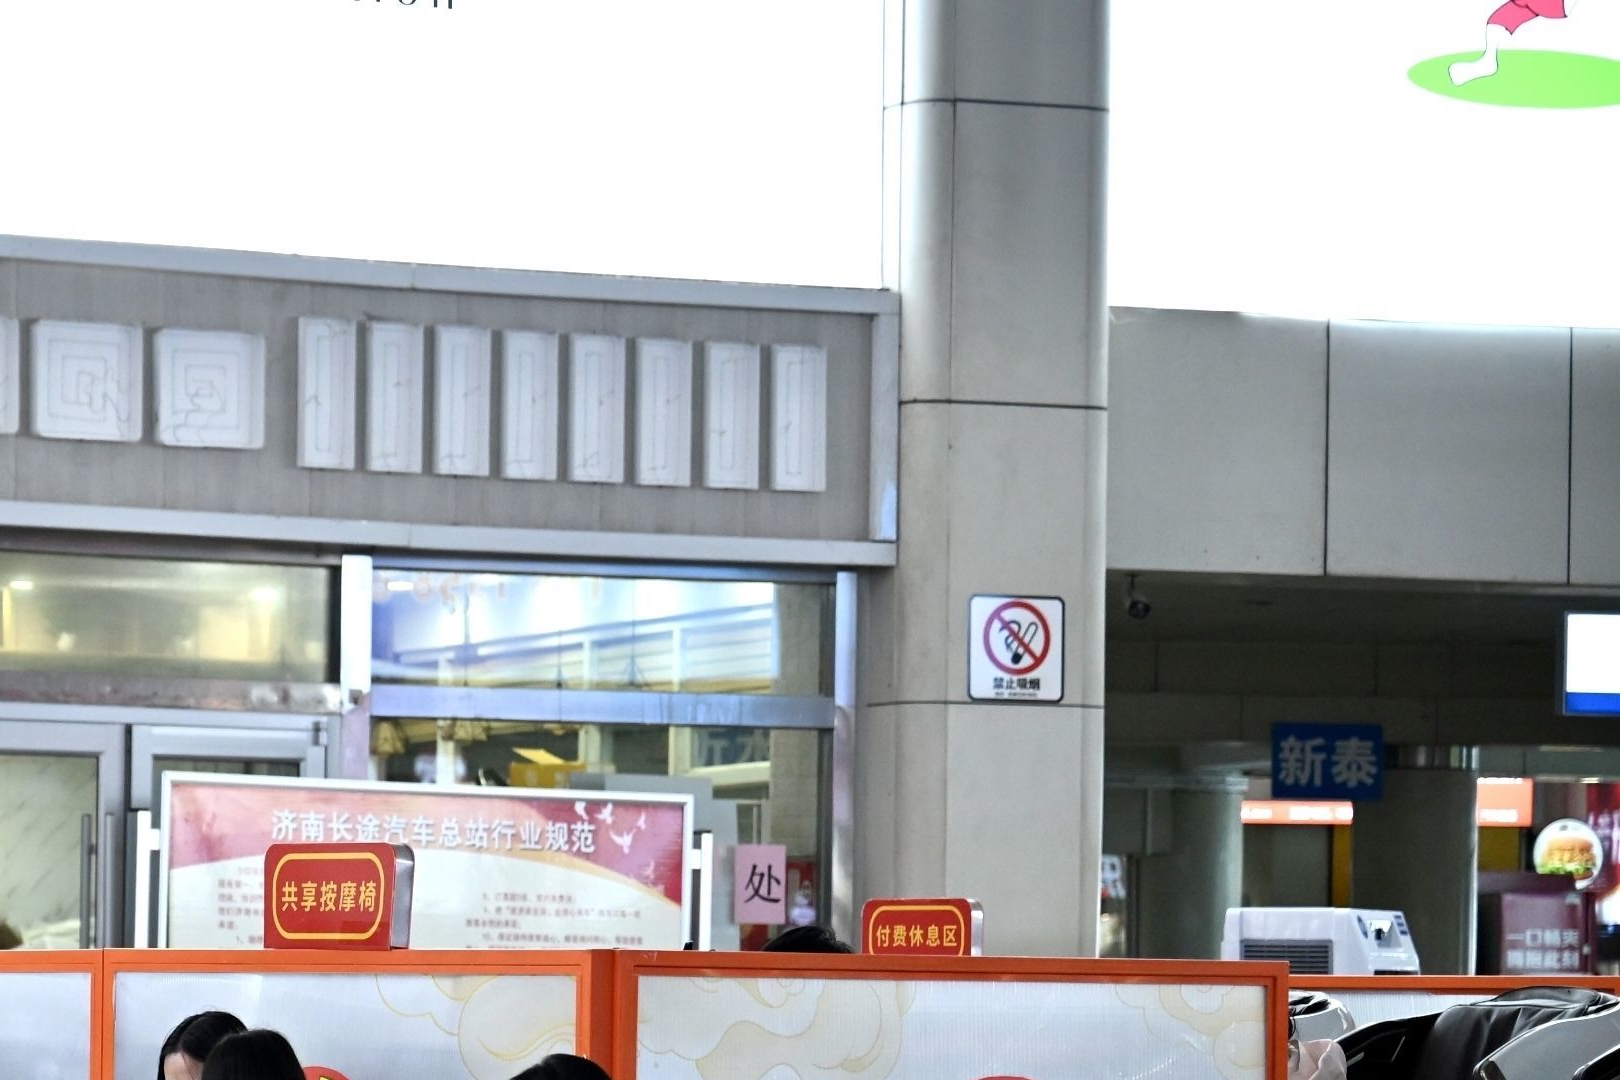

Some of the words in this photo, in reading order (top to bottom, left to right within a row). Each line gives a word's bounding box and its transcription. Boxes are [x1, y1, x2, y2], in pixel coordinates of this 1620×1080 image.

[993, 677, 1041, 690] 禁止吸烟
[1279, 735, 1378, 788] 新泰
[272, 809, 597, 853] 济南长途汽车总站行业规范
[282, 880, 377, 913] 共享按摩椅
[744, 863, 782, 903] 处
[876, 925, 957, 947] 付费休息区
